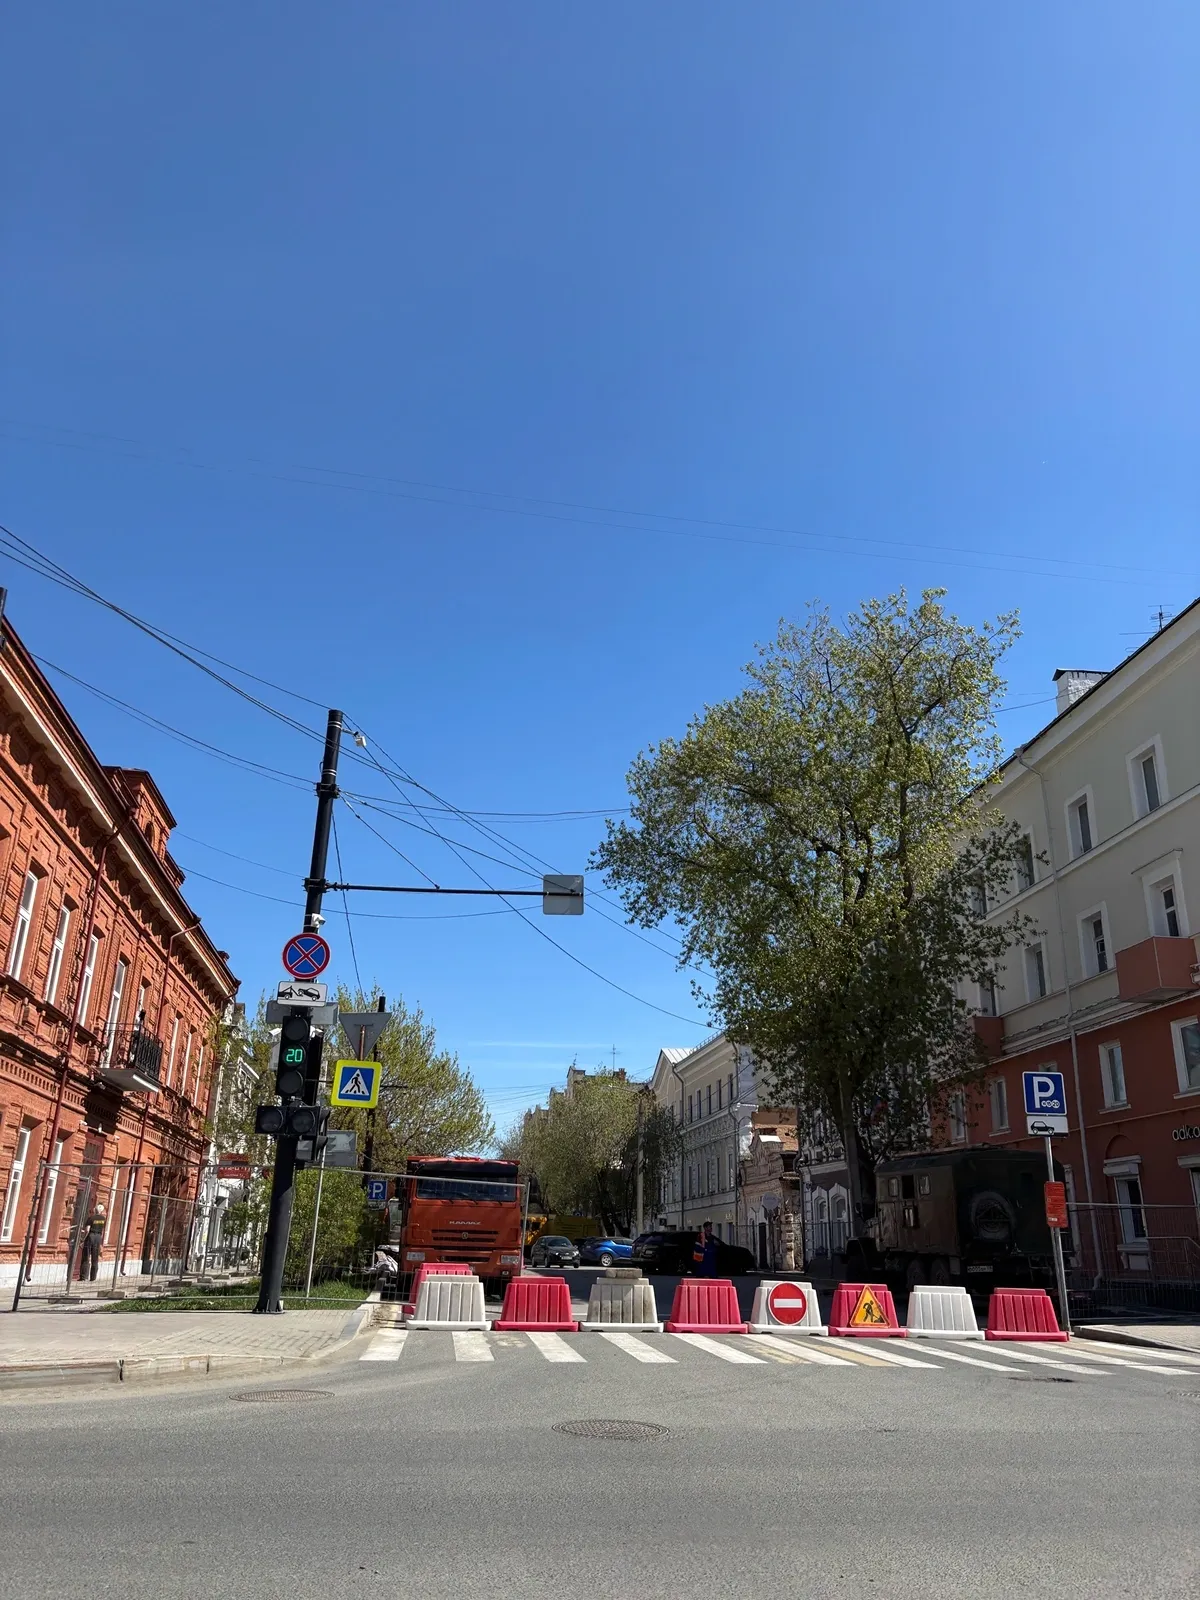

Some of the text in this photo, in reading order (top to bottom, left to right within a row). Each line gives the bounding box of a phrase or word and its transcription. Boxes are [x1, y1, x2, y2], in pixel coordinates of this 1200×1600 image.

[285, 1048, 303, 1063] 20
[1032, 1076, 1055, 1109] P
[372, 1182, 384, 1198] P
